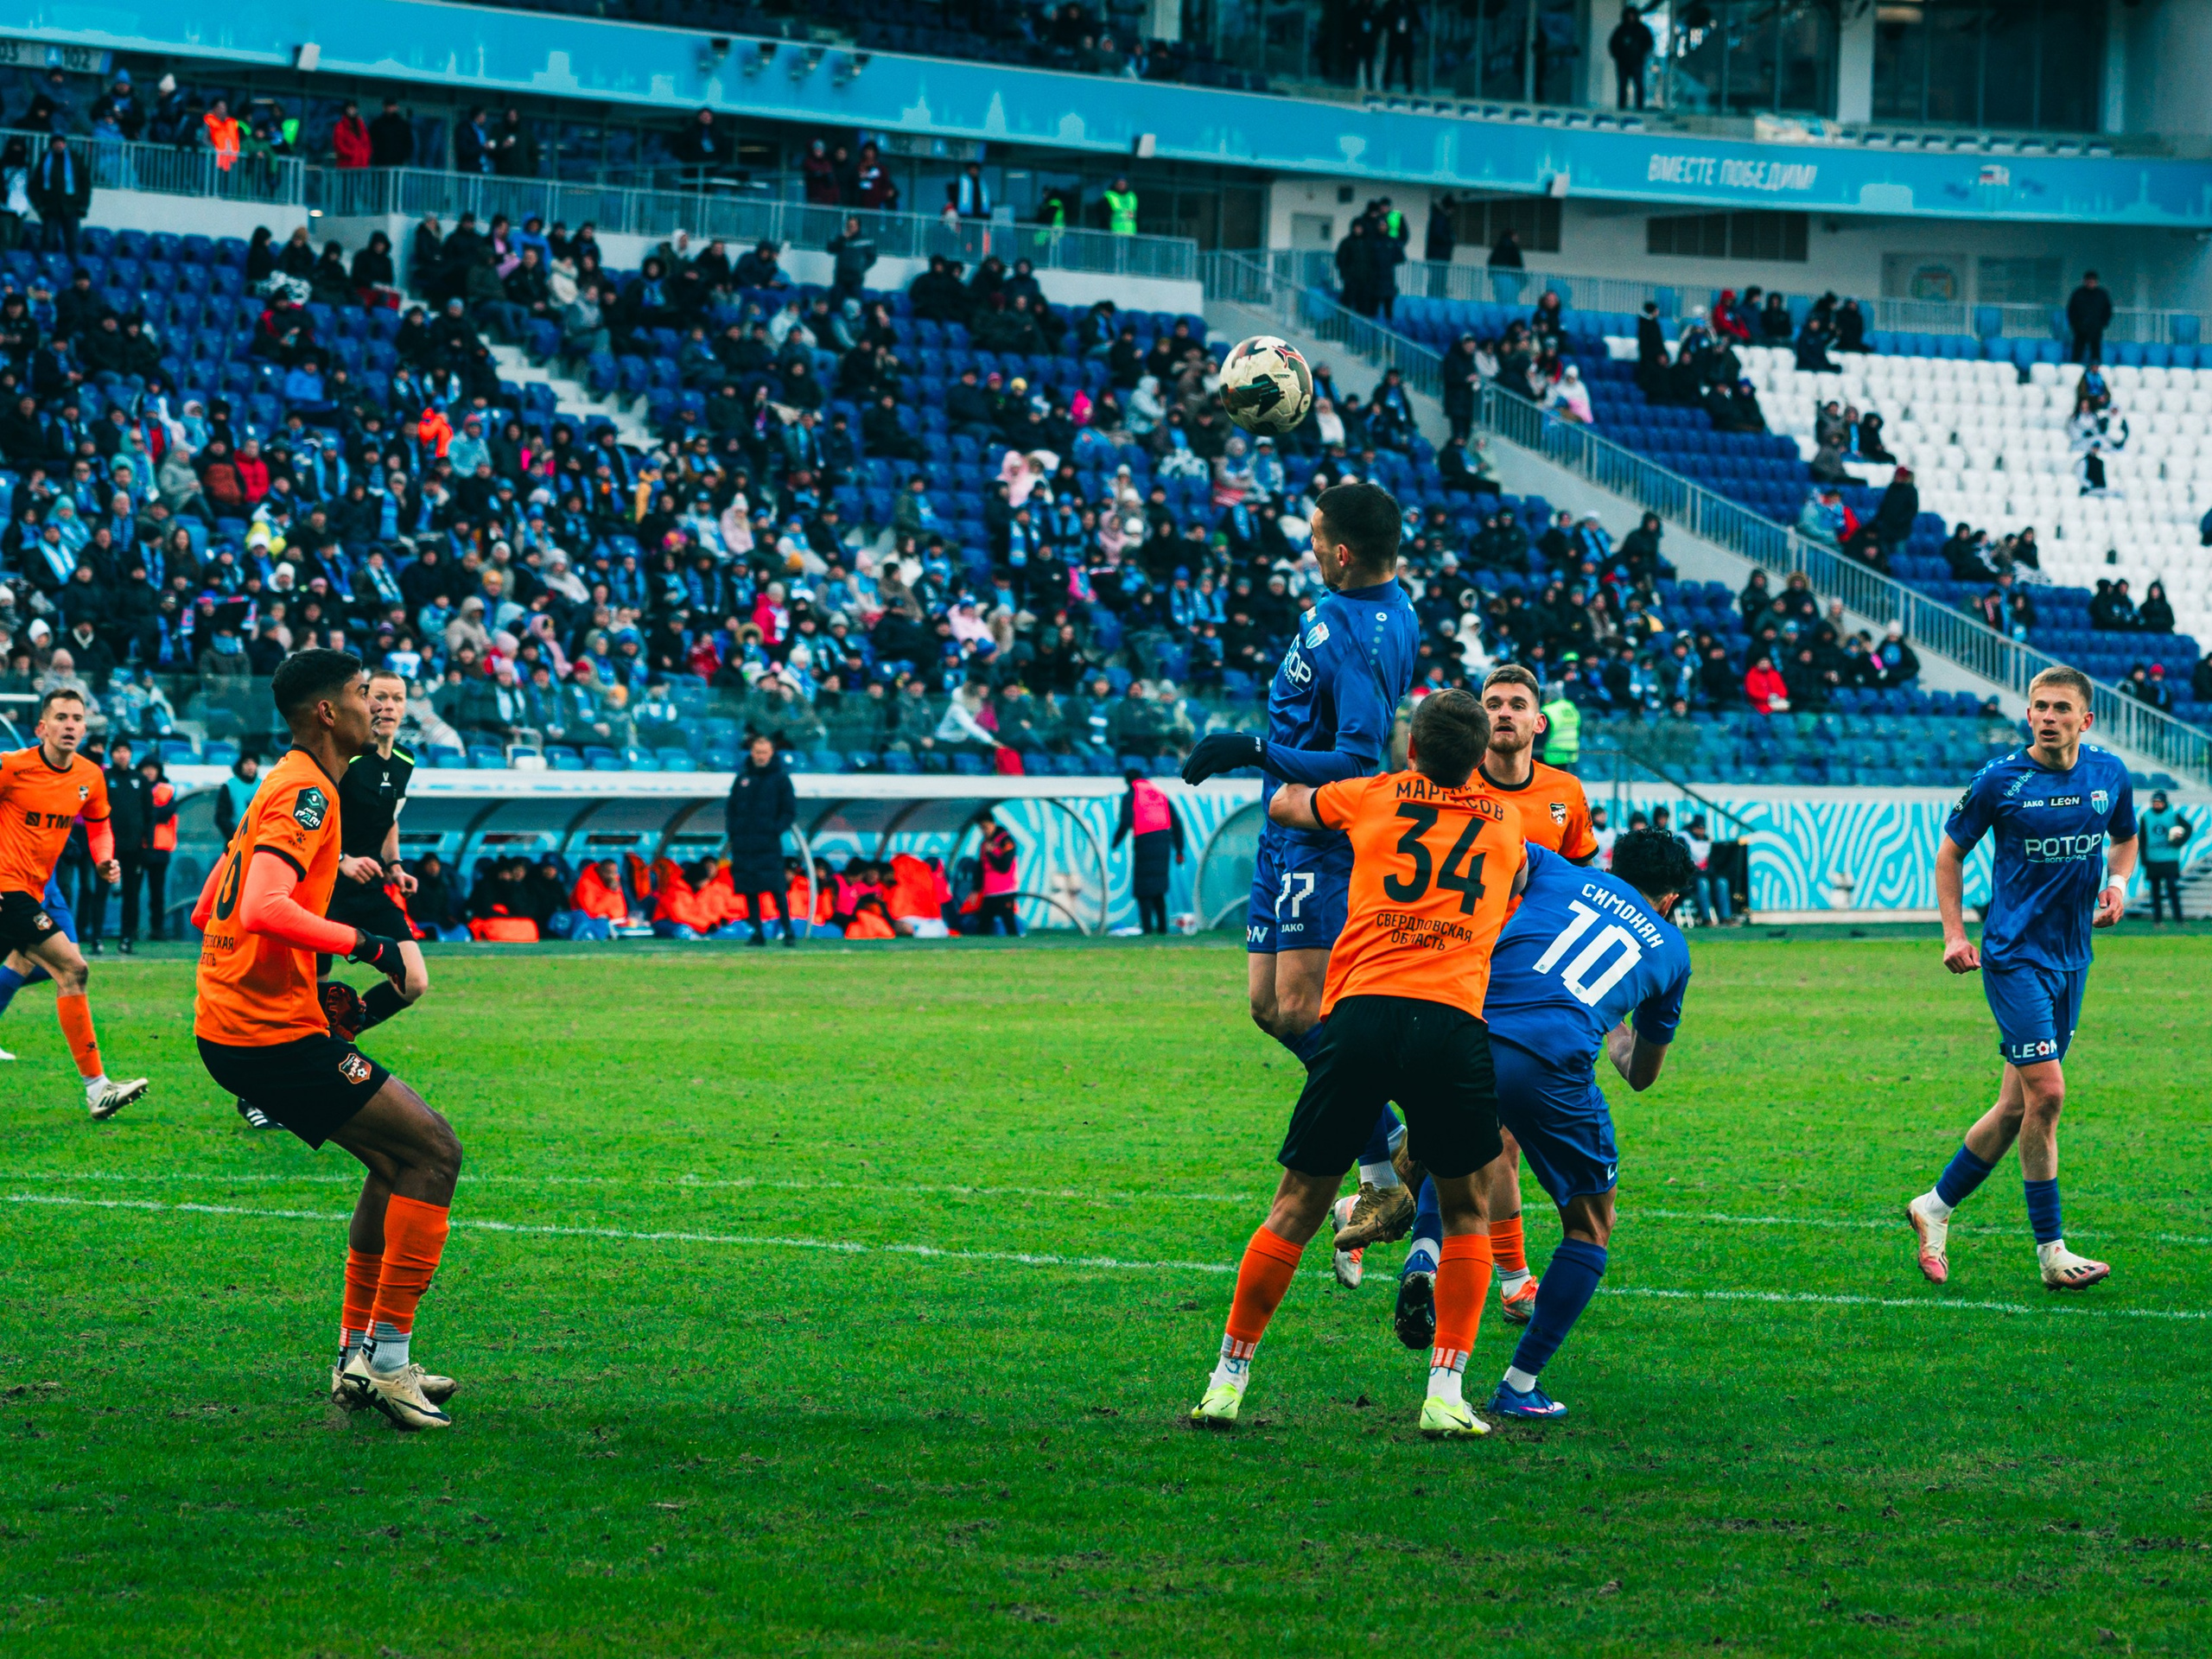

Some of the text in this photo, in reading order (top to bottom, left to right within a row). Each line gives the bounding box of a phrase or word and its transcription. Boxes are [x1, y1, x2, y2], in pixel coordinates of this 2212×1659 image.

[1648, 154, 1716, 186] ВМЕСТЕ
[2004, 768, 2037, 798] legalbet
[1395, 779, 1504, 822] МАРГСОВ
[2022, 799, 2044, 809] JAKO
[2050, 797, 2081, 807] LEON
[1383, 802, 1487, 916] 34
[2024, 833, 2102, 856] РОТОР
[1281, 923, 1305, 933] JAKO
[1376, 913, 1472, 943] СВЕРДЛОВСКАЯ
[1581, 883, 1664, 949] СИМОНЯН
[1391, 930, 1446, 950] ОБЛАСТЬ
[1532, 899, 1642, 1007] 10
